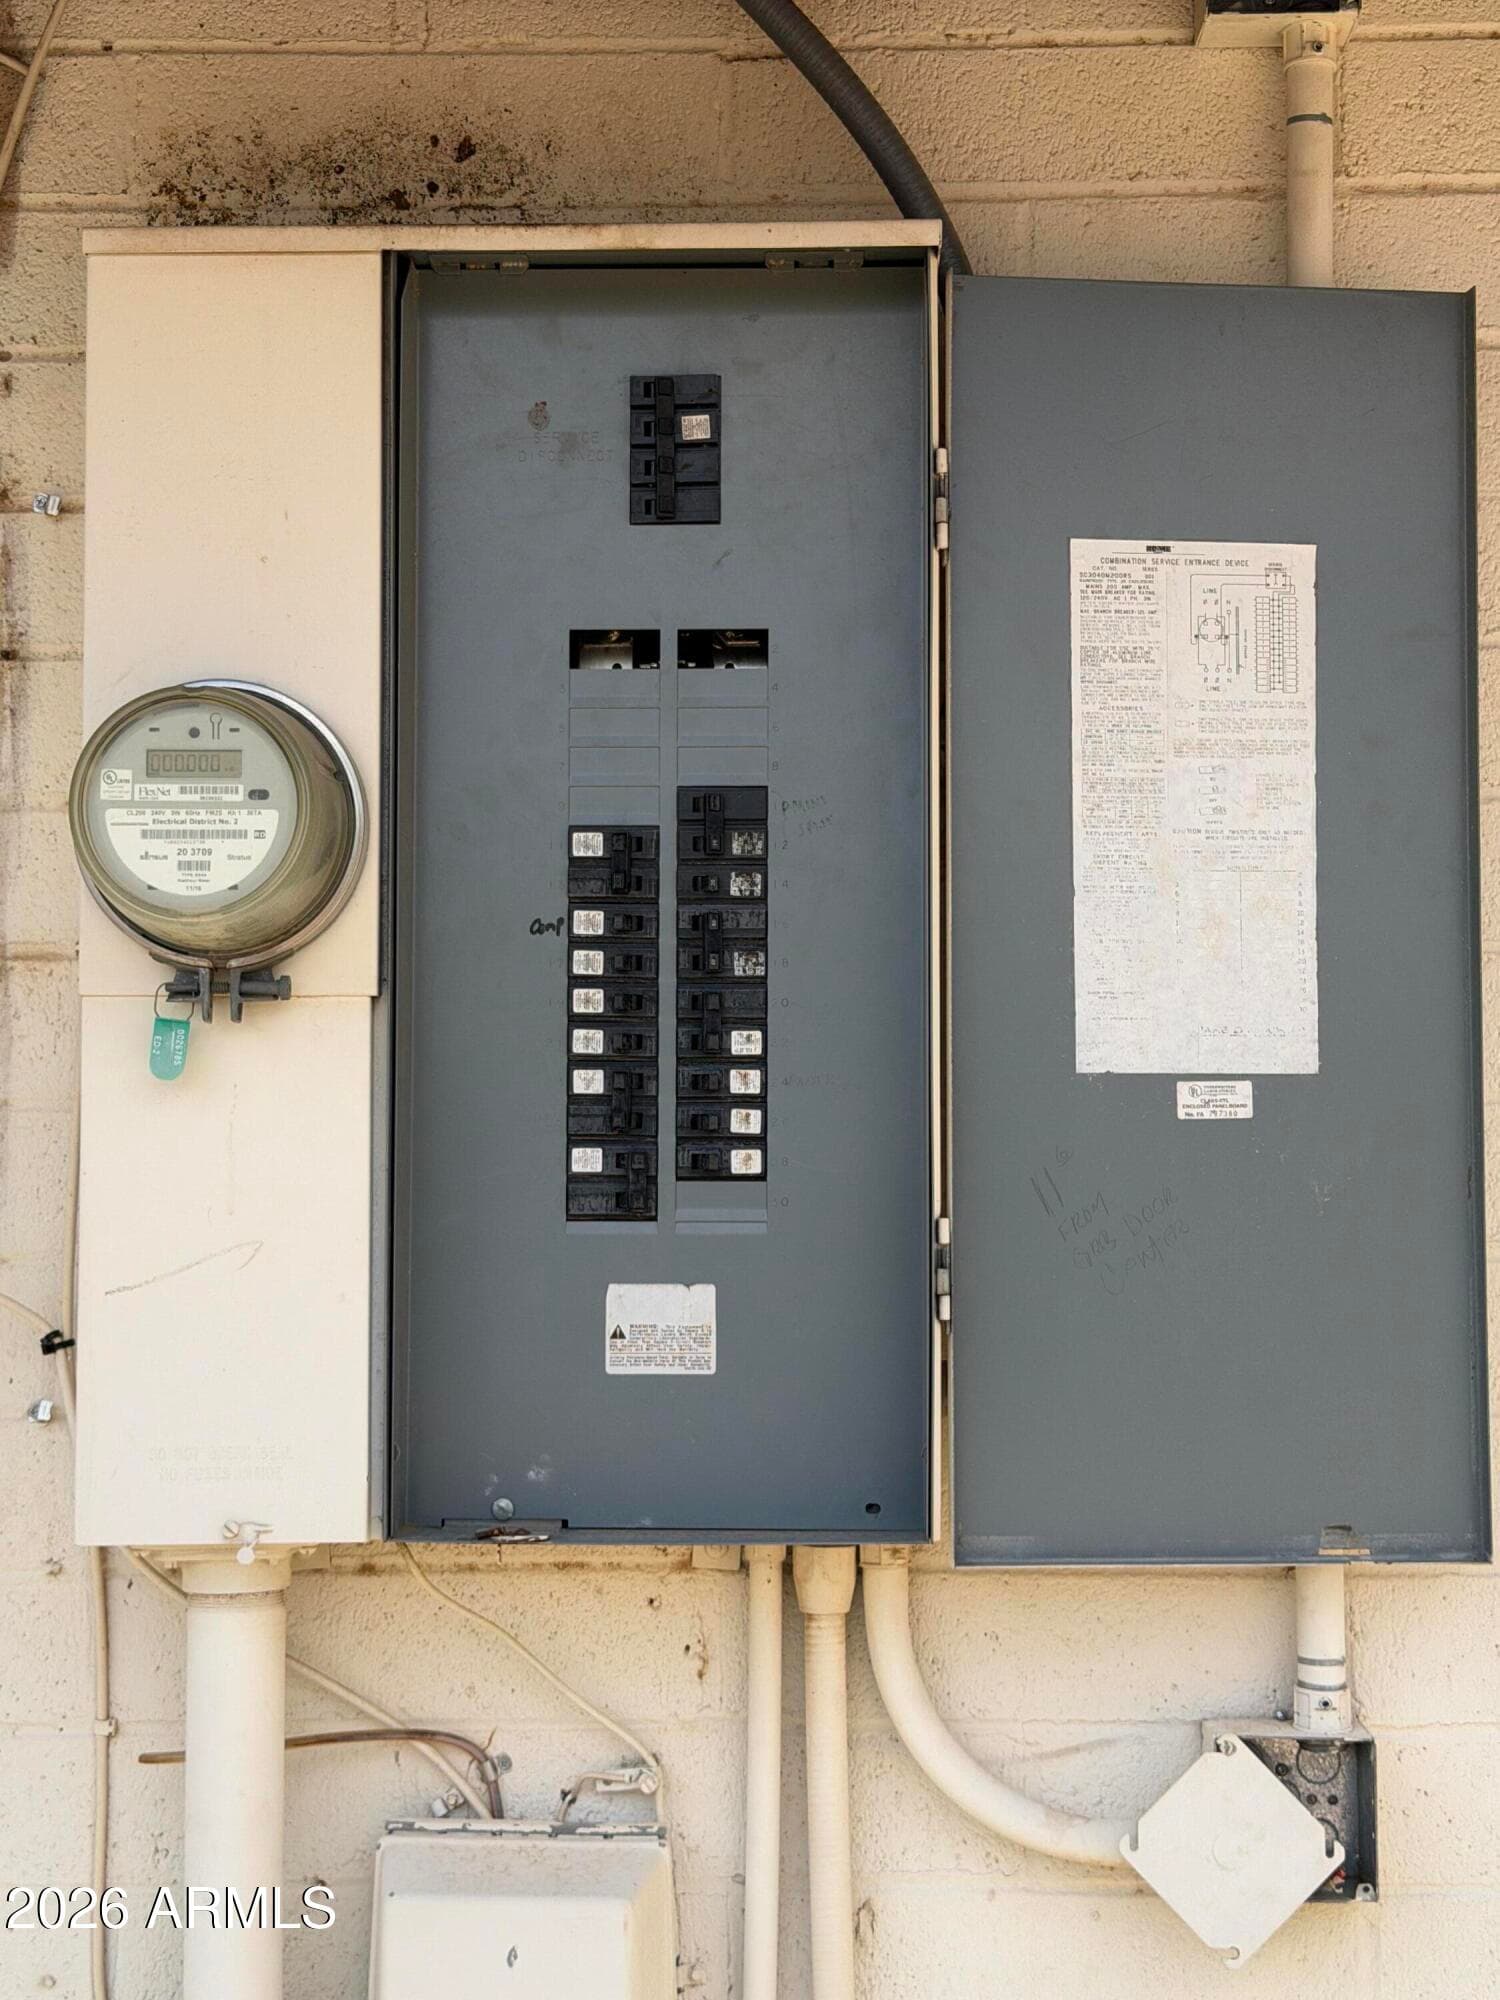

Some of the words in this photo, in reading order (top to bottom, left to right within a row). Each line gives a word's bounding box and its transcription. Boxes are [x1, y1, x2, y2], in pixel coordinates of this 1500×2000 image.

[1100, 557, 1147, 565] COMBINATION
[1151, 558, 1180, 566] SERVICE
[1184, 559, 1221, 567] ENTRANCE
[152, 817, 188, 825] Electrical
[189, 817, 217, 825] District
[176, 848, 188, 857] 20
[189, 848, 213, 857] 3709
